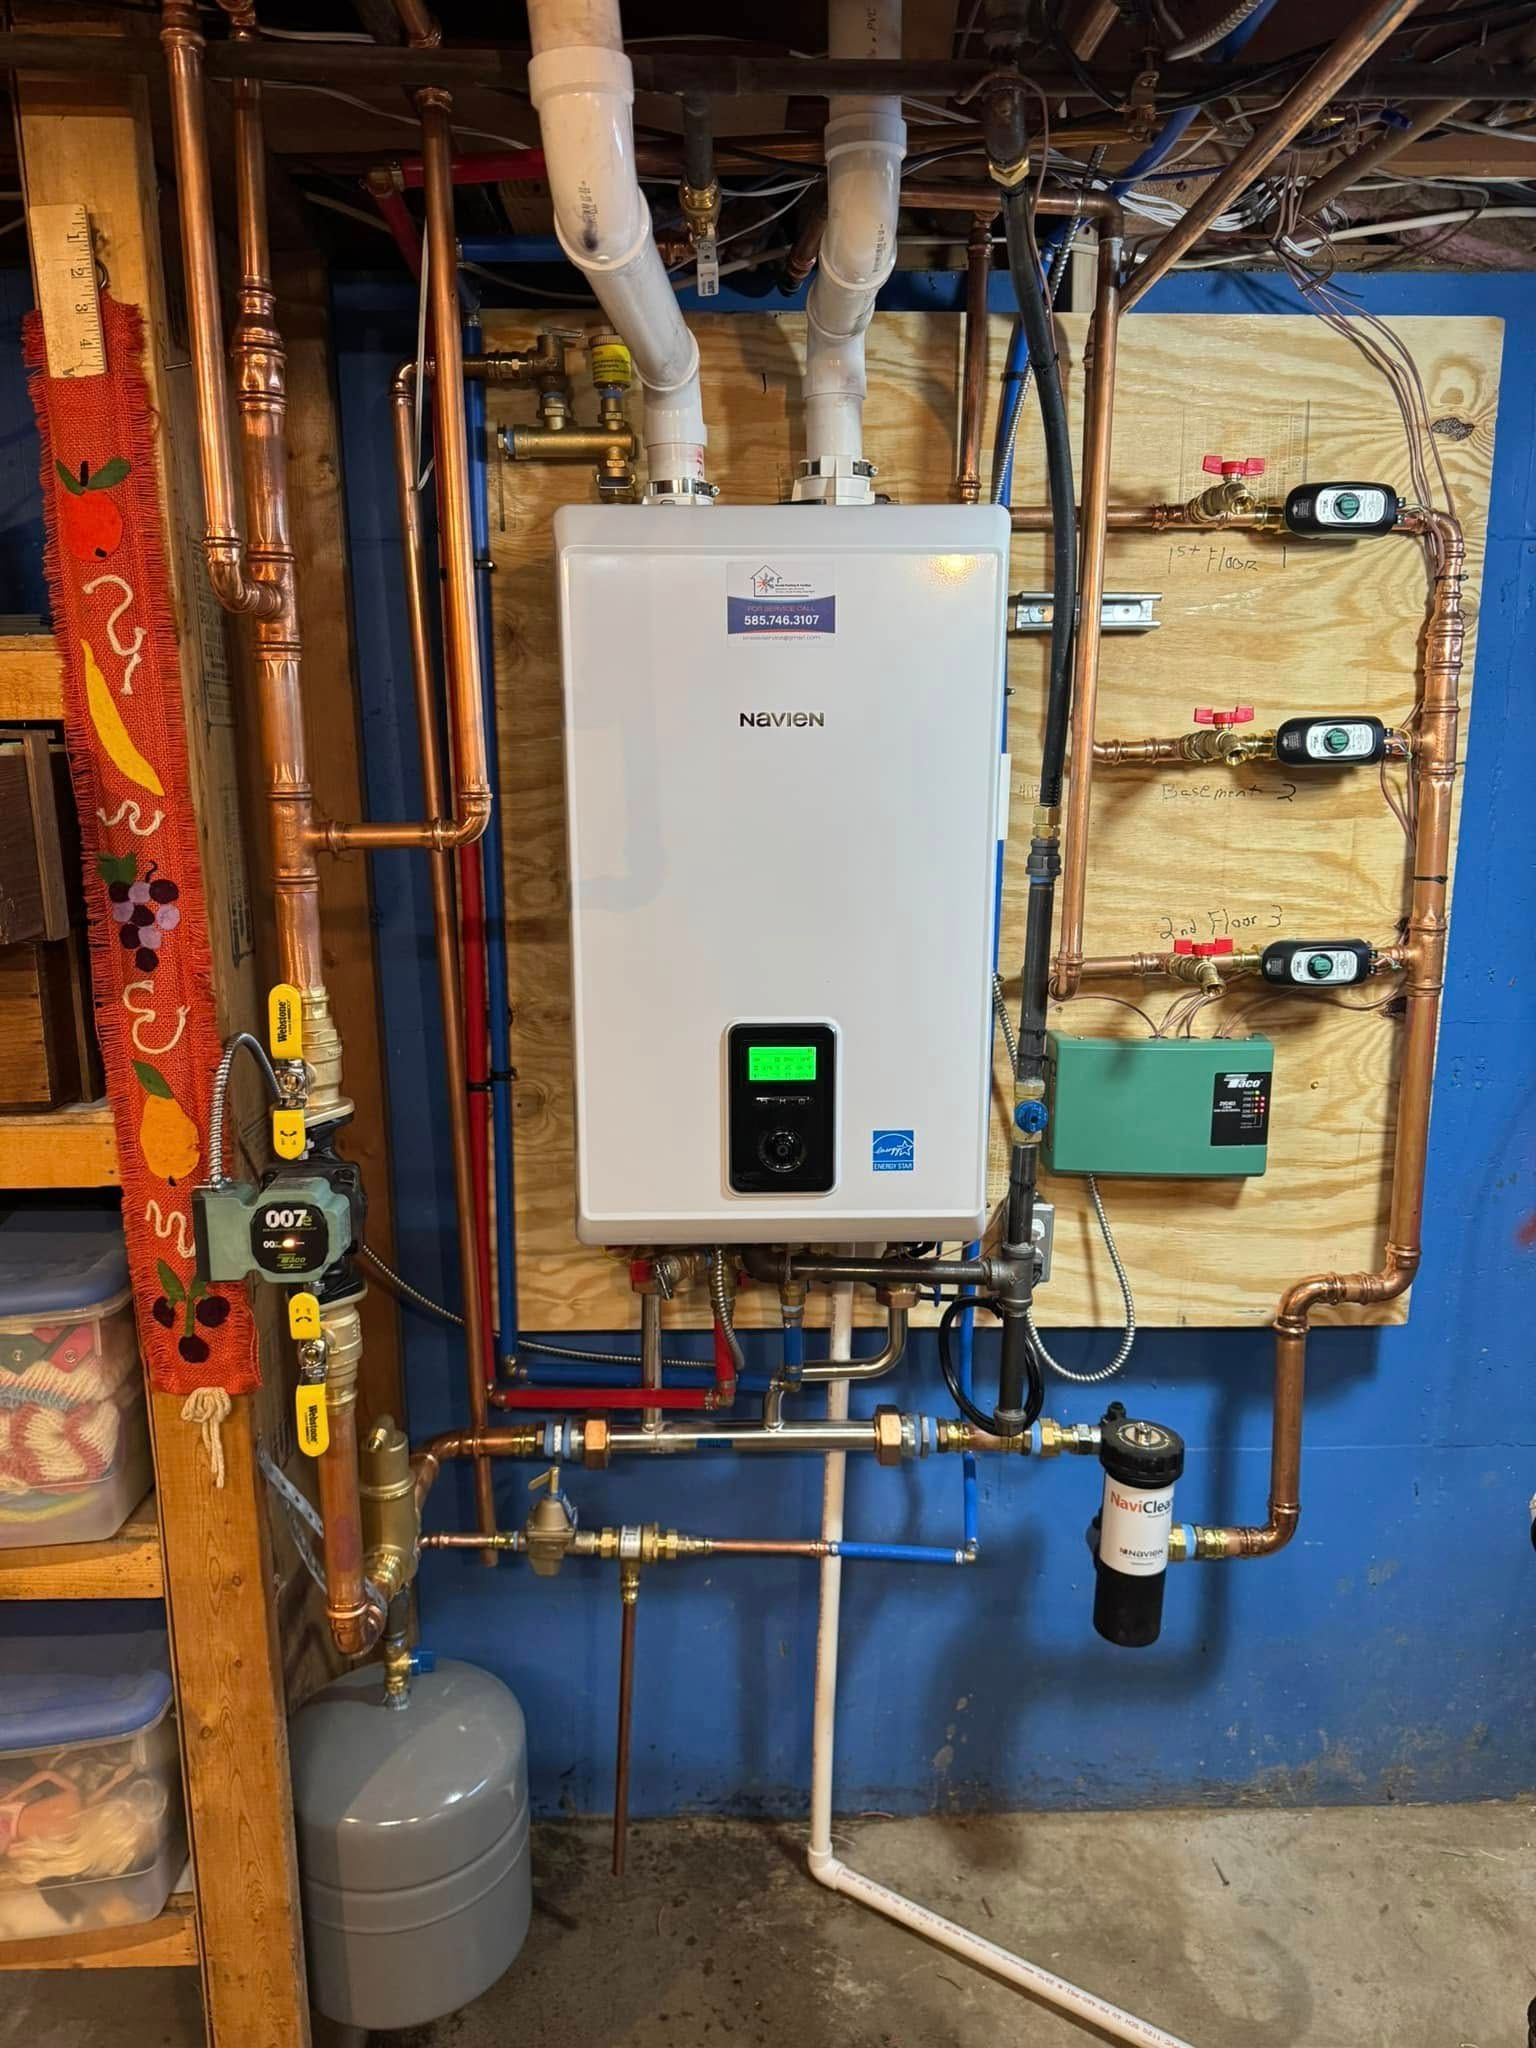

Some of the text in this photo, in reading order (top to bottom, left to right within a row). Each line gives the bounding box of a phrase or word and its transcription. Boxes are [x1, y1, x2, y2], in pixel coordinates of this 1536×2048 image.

[70, 267, 85, 278] 2
[75, 303, 89, 313] 3
[80, 338, 93, 347] 4
[744, 615, 819, 626] 585.746.3107
[1160, 904, 1283, 939] 2nd Floor 3
[277, 1001, 288, 1043] Webstone
[1224, 1073, 1261, 1088] Taco
[308, 1404, 319, 1443] Webstone
